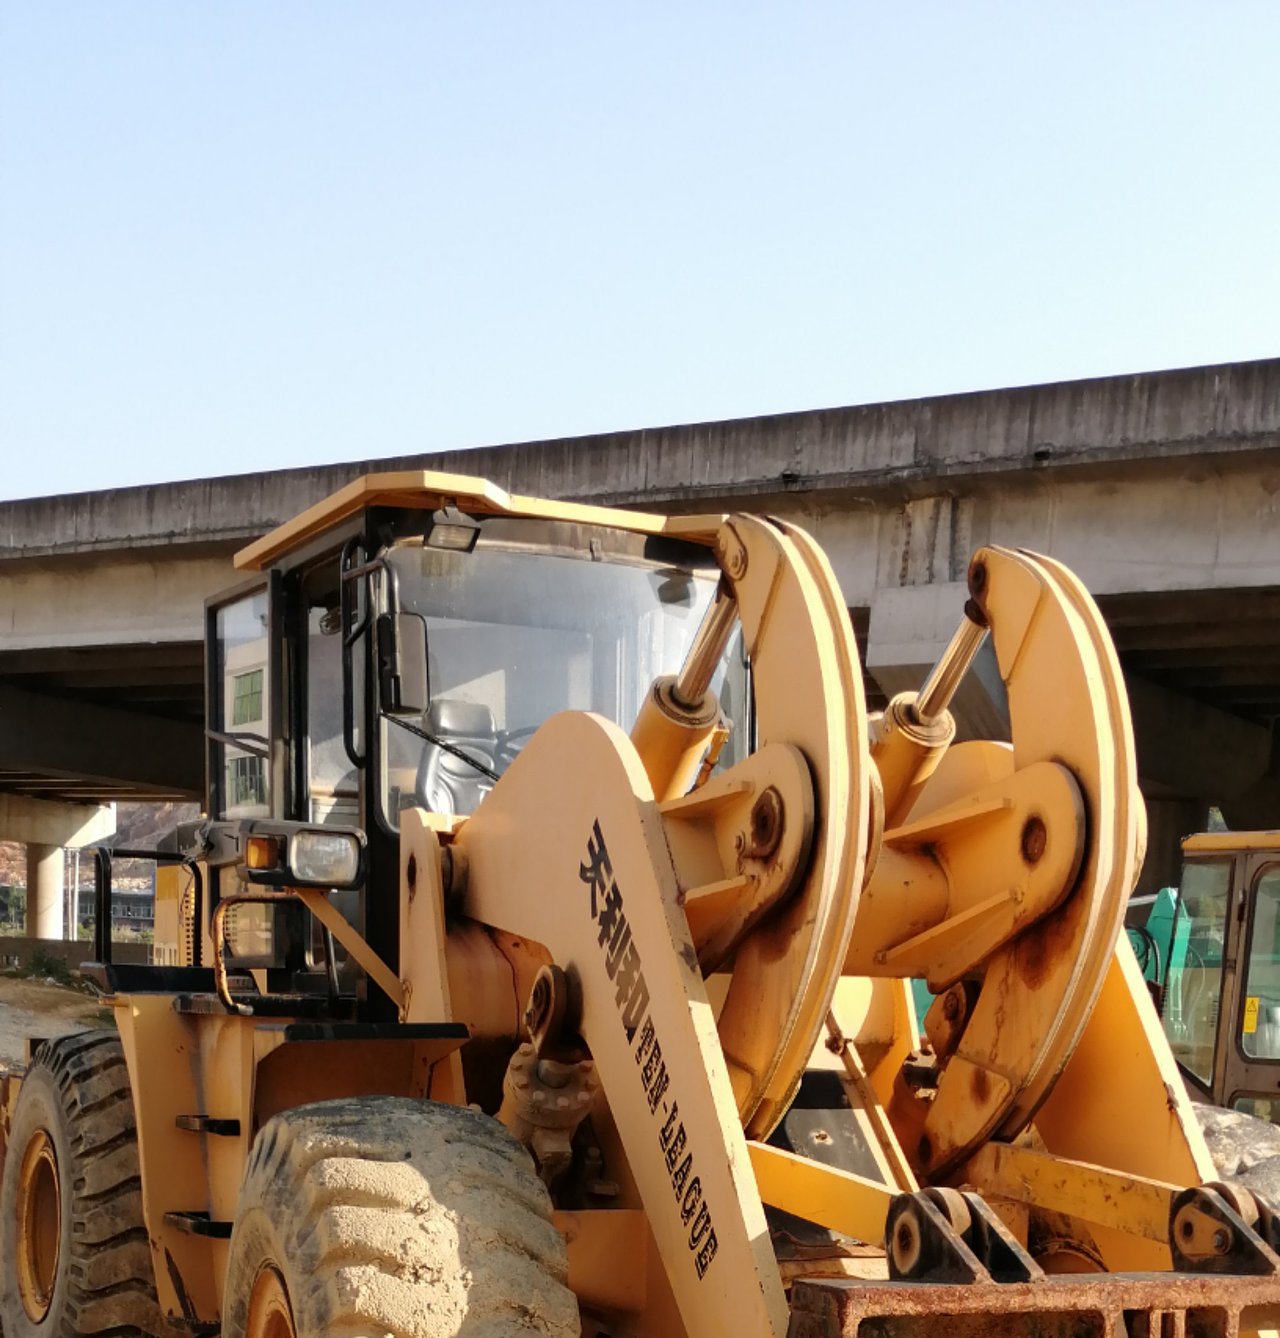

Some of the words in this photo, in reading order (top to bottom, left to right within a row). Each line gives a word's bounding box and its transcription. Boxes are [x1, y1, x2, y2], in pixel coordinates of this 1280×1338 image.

[579, 817, 651, 1045] 天利和
[635, 1014, 719, 1281] TEN-LEAGUE
